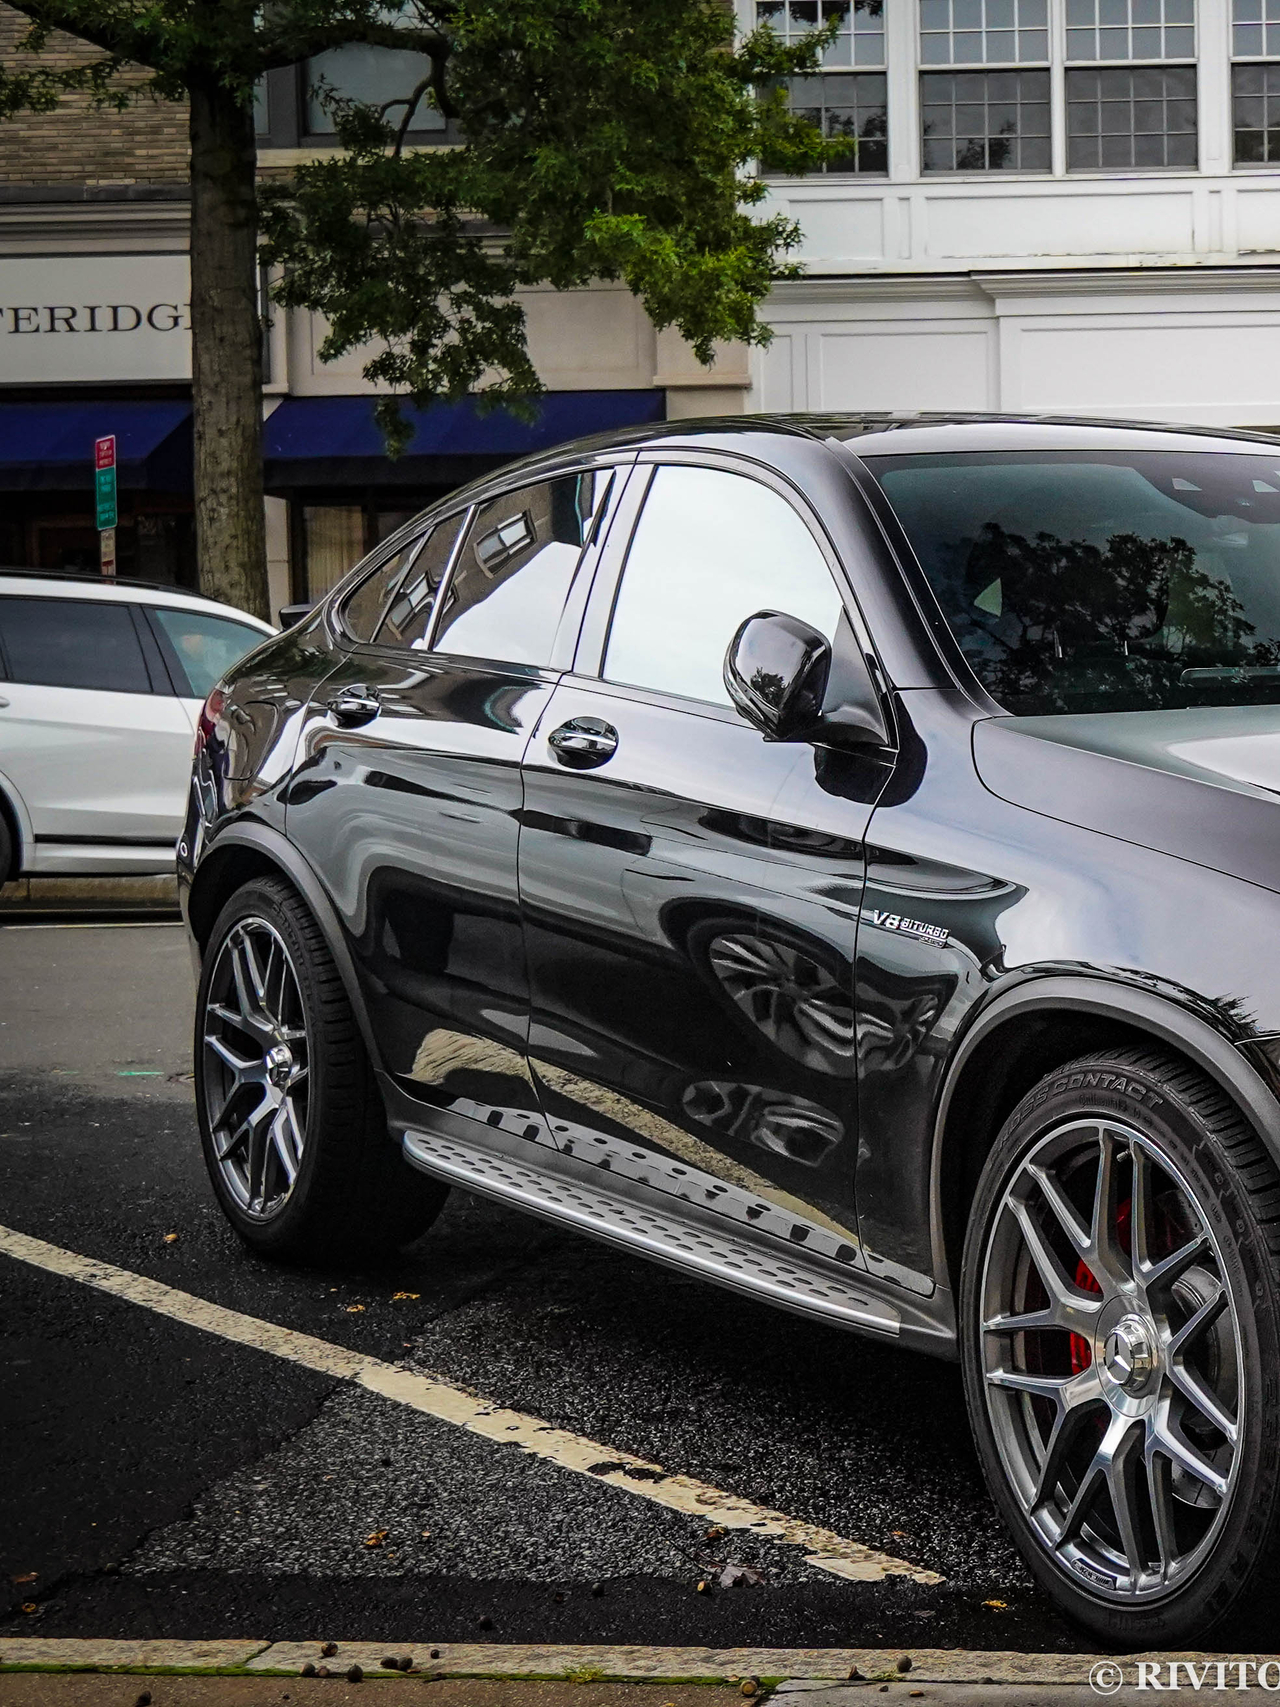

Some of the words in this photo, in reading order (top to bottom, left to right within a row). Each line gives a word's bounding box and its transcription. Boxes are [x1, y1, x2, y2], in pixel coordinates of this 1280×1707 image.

[0, 303, 192, 334] ERIDG
[873, 909, 901, 929] V8
[900, 917, 949, 939] BITURBO
[1052, 1072, 1164, 1109] CONTACT
